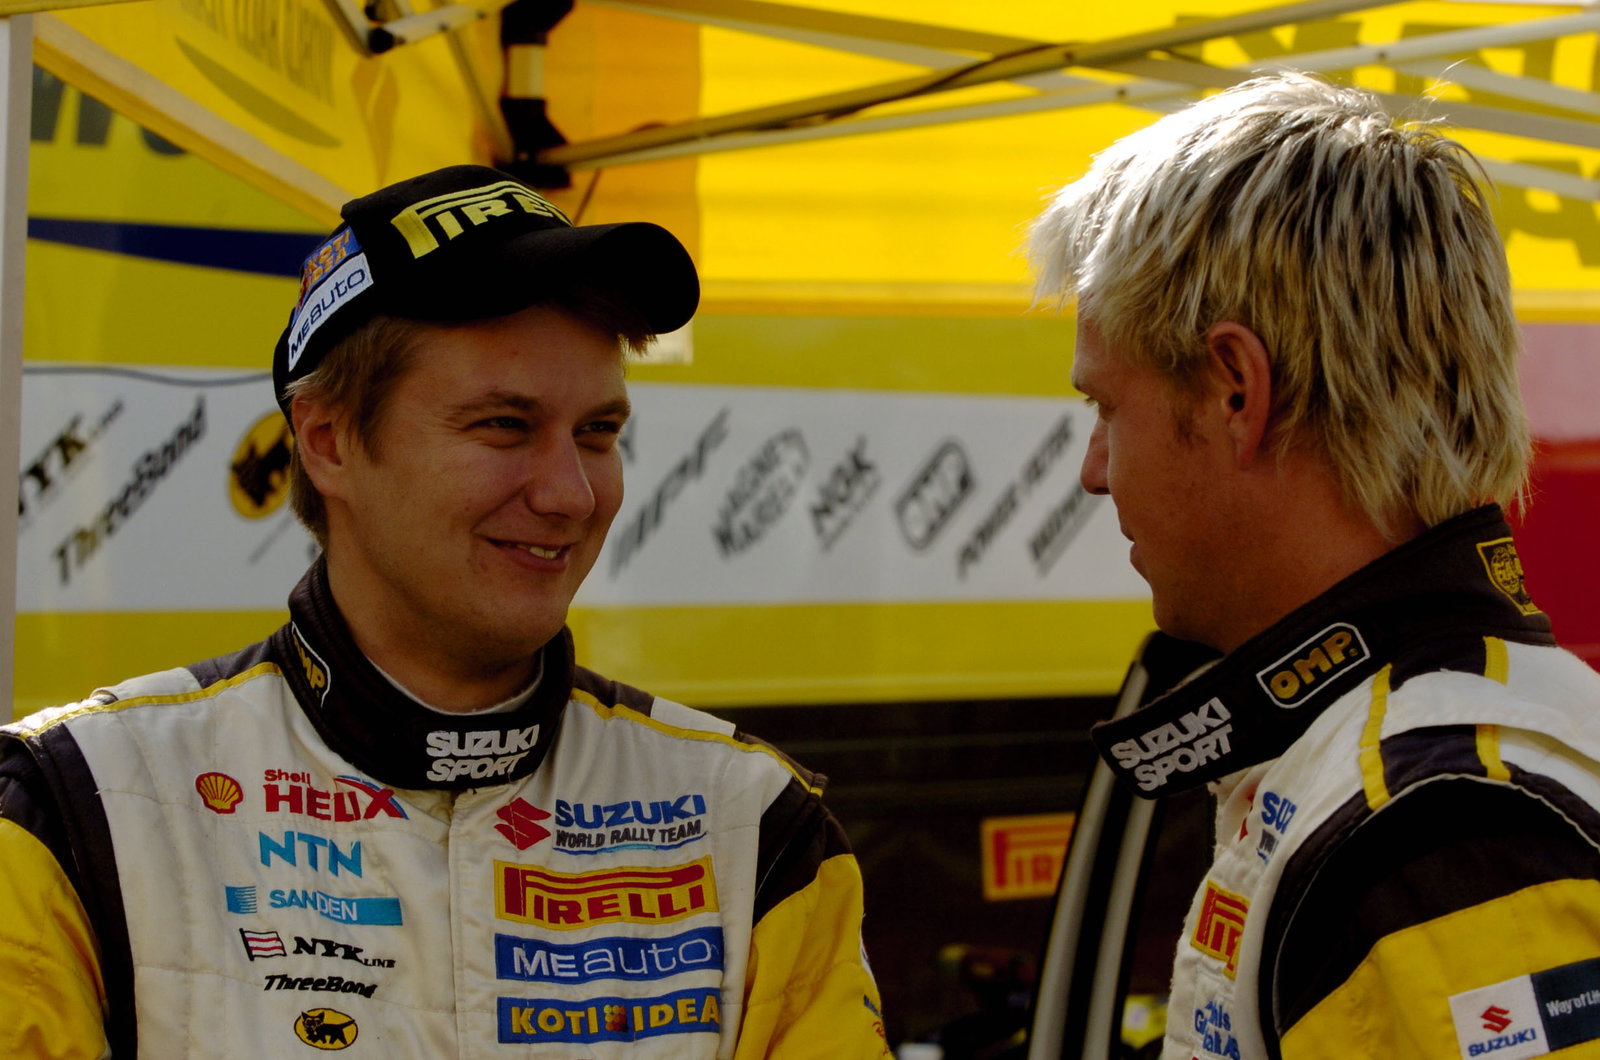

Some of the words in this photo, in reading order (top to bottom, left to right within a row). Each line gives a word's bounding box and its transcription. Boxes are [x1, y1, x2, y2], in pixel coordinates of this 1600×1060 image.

[426, 724, 540, 757] SUZUKI
[1111, 697, 1232, 769] SUZUKI
[426, 751, 530, 782] SPORT
[1134, 725, 1233, 792] SPORT
[264, 769, 311, 786] Shell
[263, 777, 405, 822] HELIX
[555, 795, 707, 829] SUZUKI
[555, 829, 605, 848] WORLD
[610, 827, 656, 844] RALLY
[659, 819, 701, 843] TEAM
[259, 831, 362, 878] NTN
[269, 889, 358, 921] SANDEN
[504, 864, 705, 924] PIRELLI
[293, 936, 364, 963] NYK
[363, 958, 395, 968] LINE
[513, 939, 712, 977] MEauto
[264, 974, 378, 998] ThreeBond
[511, 1006, 599, 1035] KOTI
[633, 995, 720, 1032] IDEA
[1545, 999, 1573, 1017] Way
[1572, 993, 1586, 1008] of
[1467, 1027, 1537, 1057] SUZUKI
